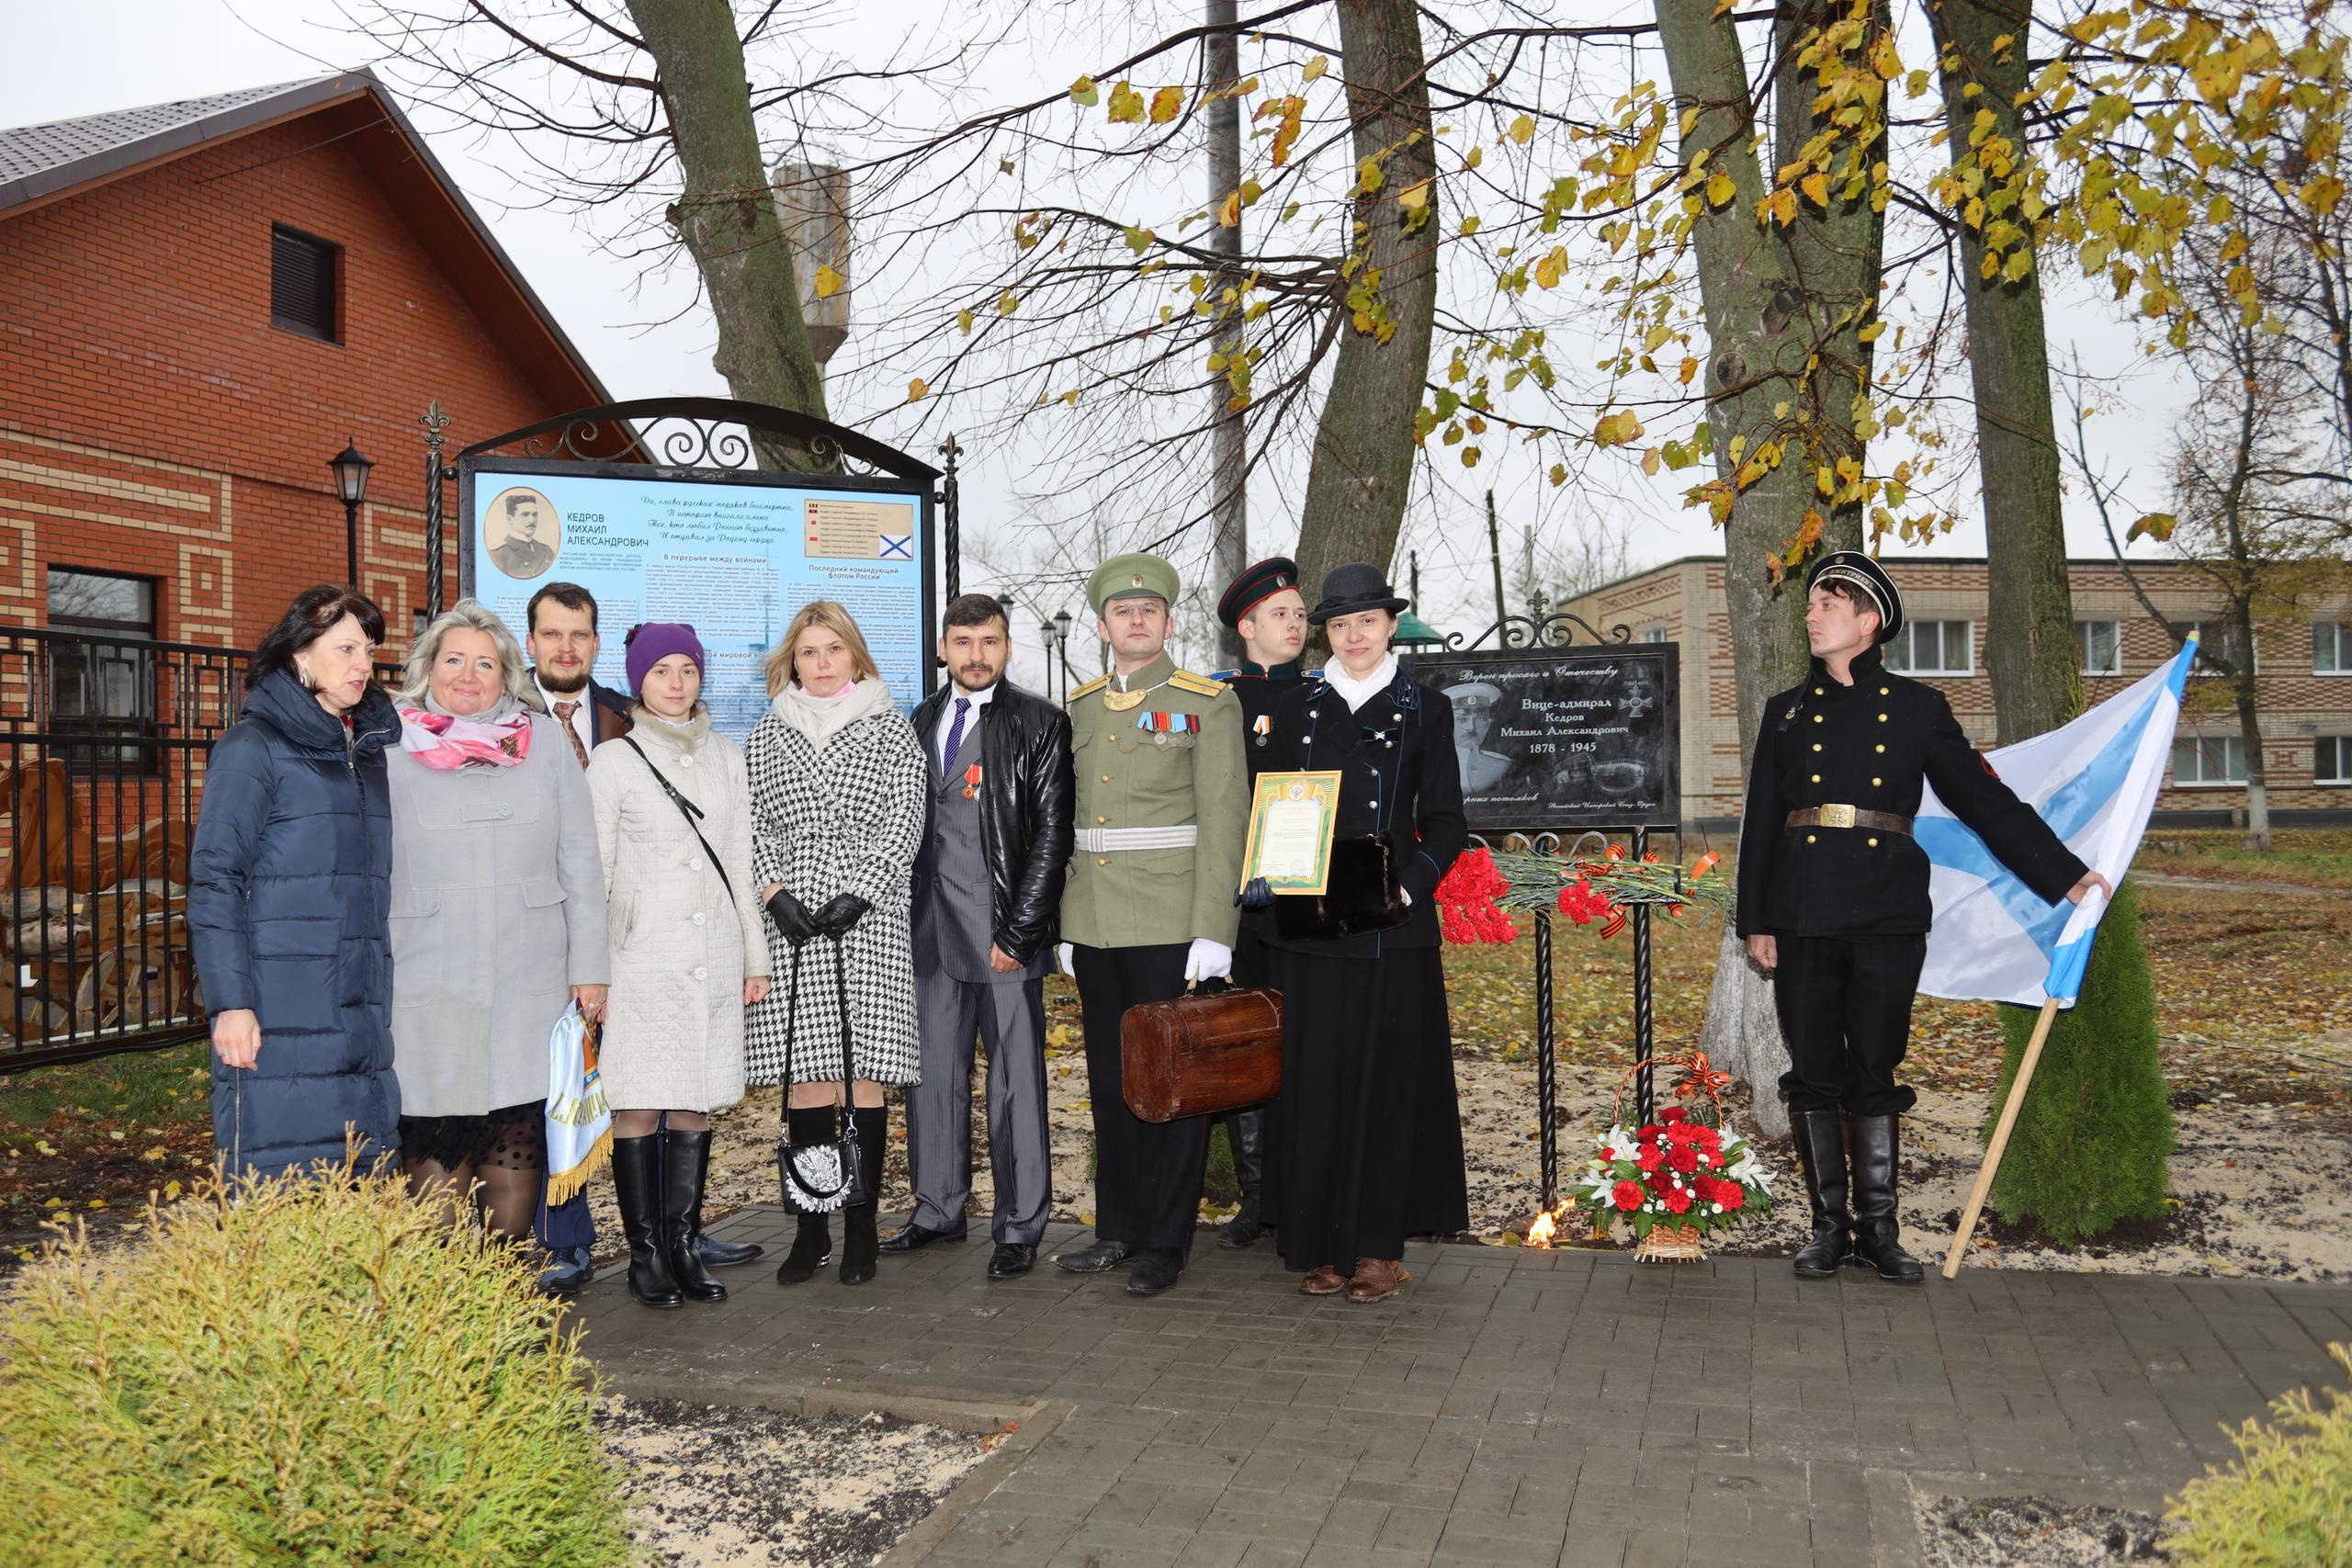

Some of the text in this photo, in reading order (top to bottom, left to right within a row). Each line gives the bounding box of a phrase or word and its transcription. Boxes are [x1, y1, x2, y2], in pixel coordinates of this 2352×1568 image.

[567, 513, 605, 523] КЕДРОВ
[567, 525, 607, 534] МИХАИЛ
[567, 536, 649, 547] АЛЕКСАНДРОВИЧ
[1555, 665, 1618, 679] Отечеству
[1521, 698, 1611, 711] Вице-адмирал
[1545, 713, 1584, 723] Кедров
[1500, 726, 1629, 737] Михаил Александрович
[1529, 743, 1555, 753] 1878
[1570, 742, 1597, 752] 1945
[1490, 793, 1539, 801] потомков
